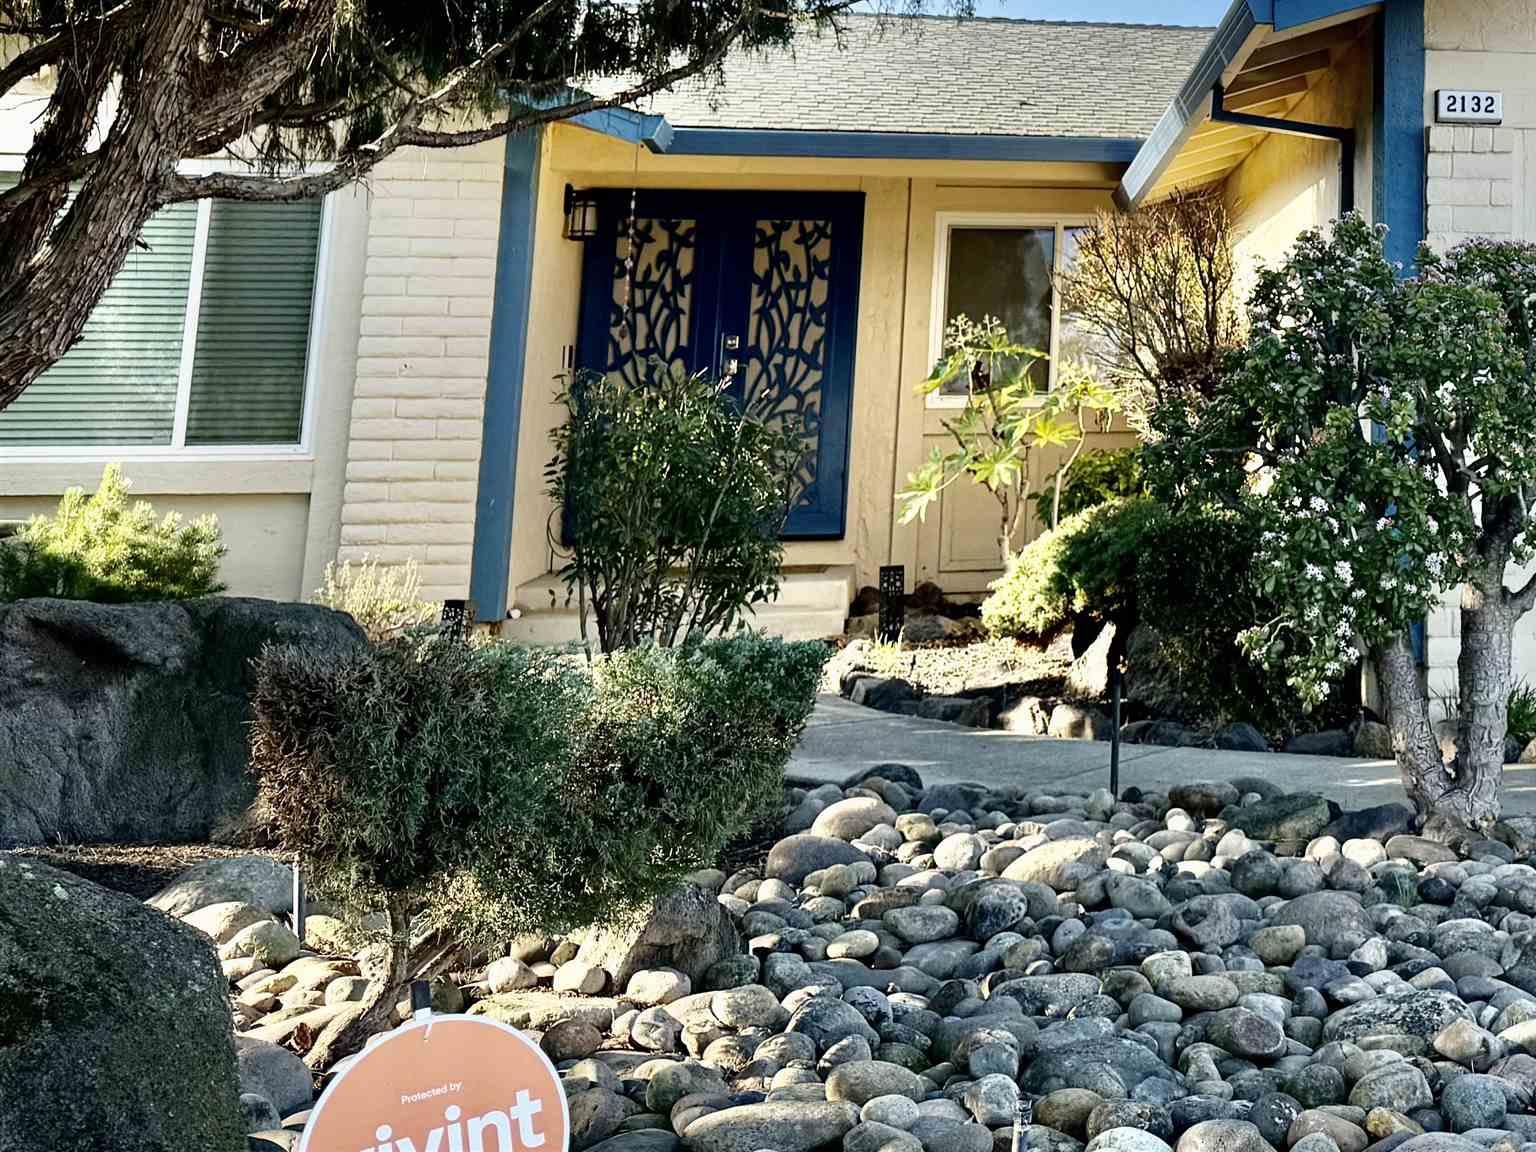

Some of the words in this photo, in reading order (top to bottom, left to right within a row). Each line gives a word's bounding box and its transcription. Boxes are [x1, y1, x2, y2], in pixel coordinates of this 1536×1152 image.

[1446, 95, 1495, 113] 2132
[401, 1083, 448, 1105] Protected
[449, 1080, 463, 1093] by
[360, 1089, 546, 1152] vint
